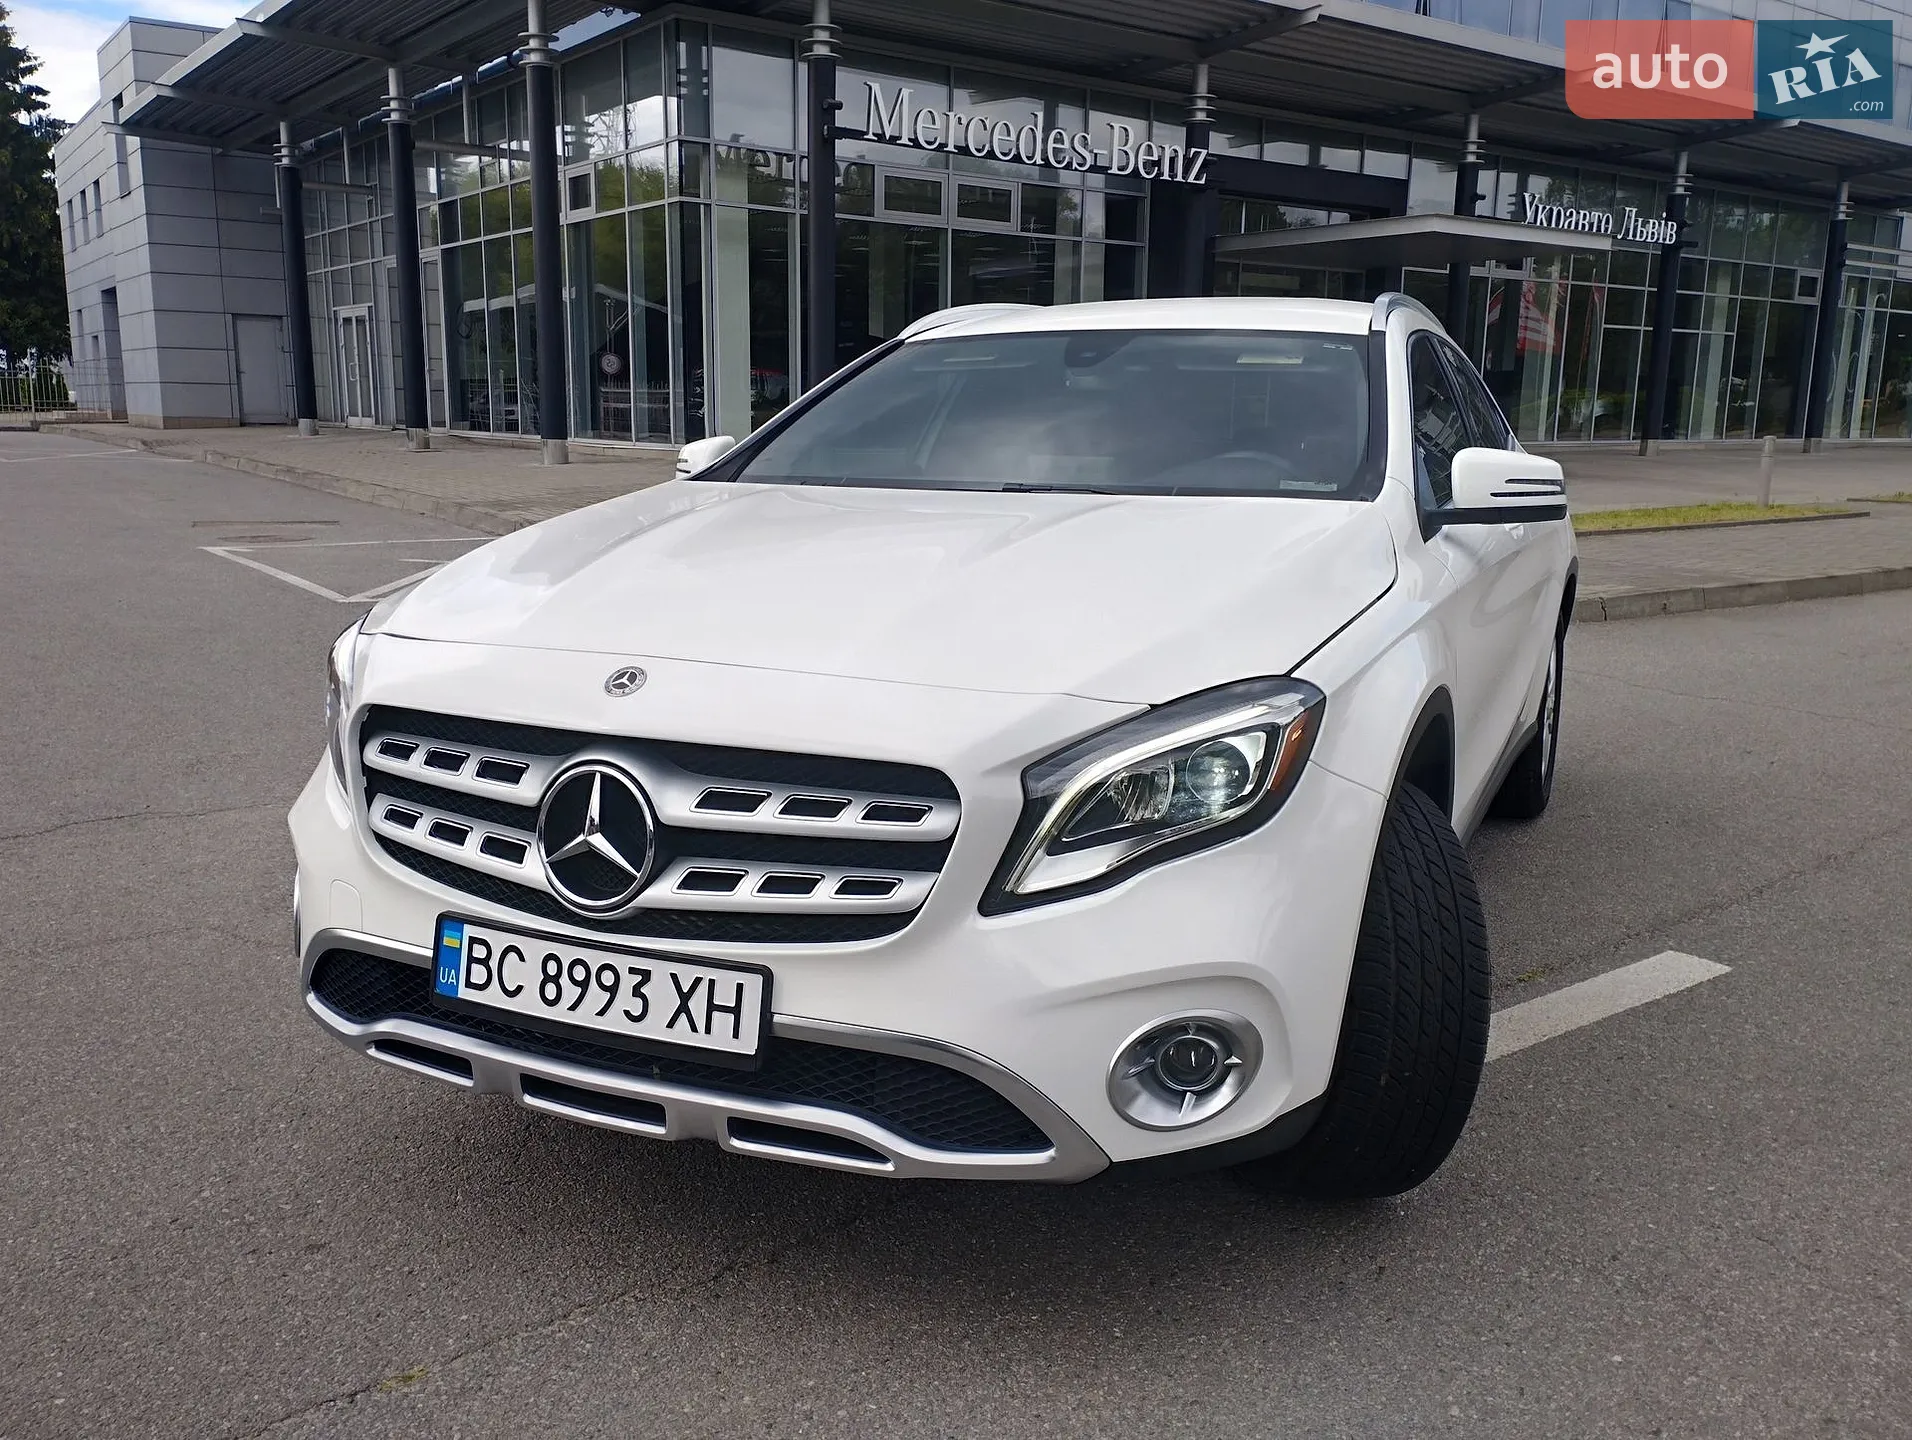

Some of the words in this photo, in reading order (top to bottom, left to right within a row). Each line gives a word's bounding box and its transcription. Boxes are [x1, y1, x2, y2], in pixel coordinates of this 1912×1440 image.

[863, 80, 1210, 184] Mercedes-Benz
[1617, 206, 1678, 245] Львів
[439, 966, 457, 986] UA
[464, 935, 526, 998] BC
[539, 953, 652, 1023] 8993
[665, 972, 744, 1039] XH
